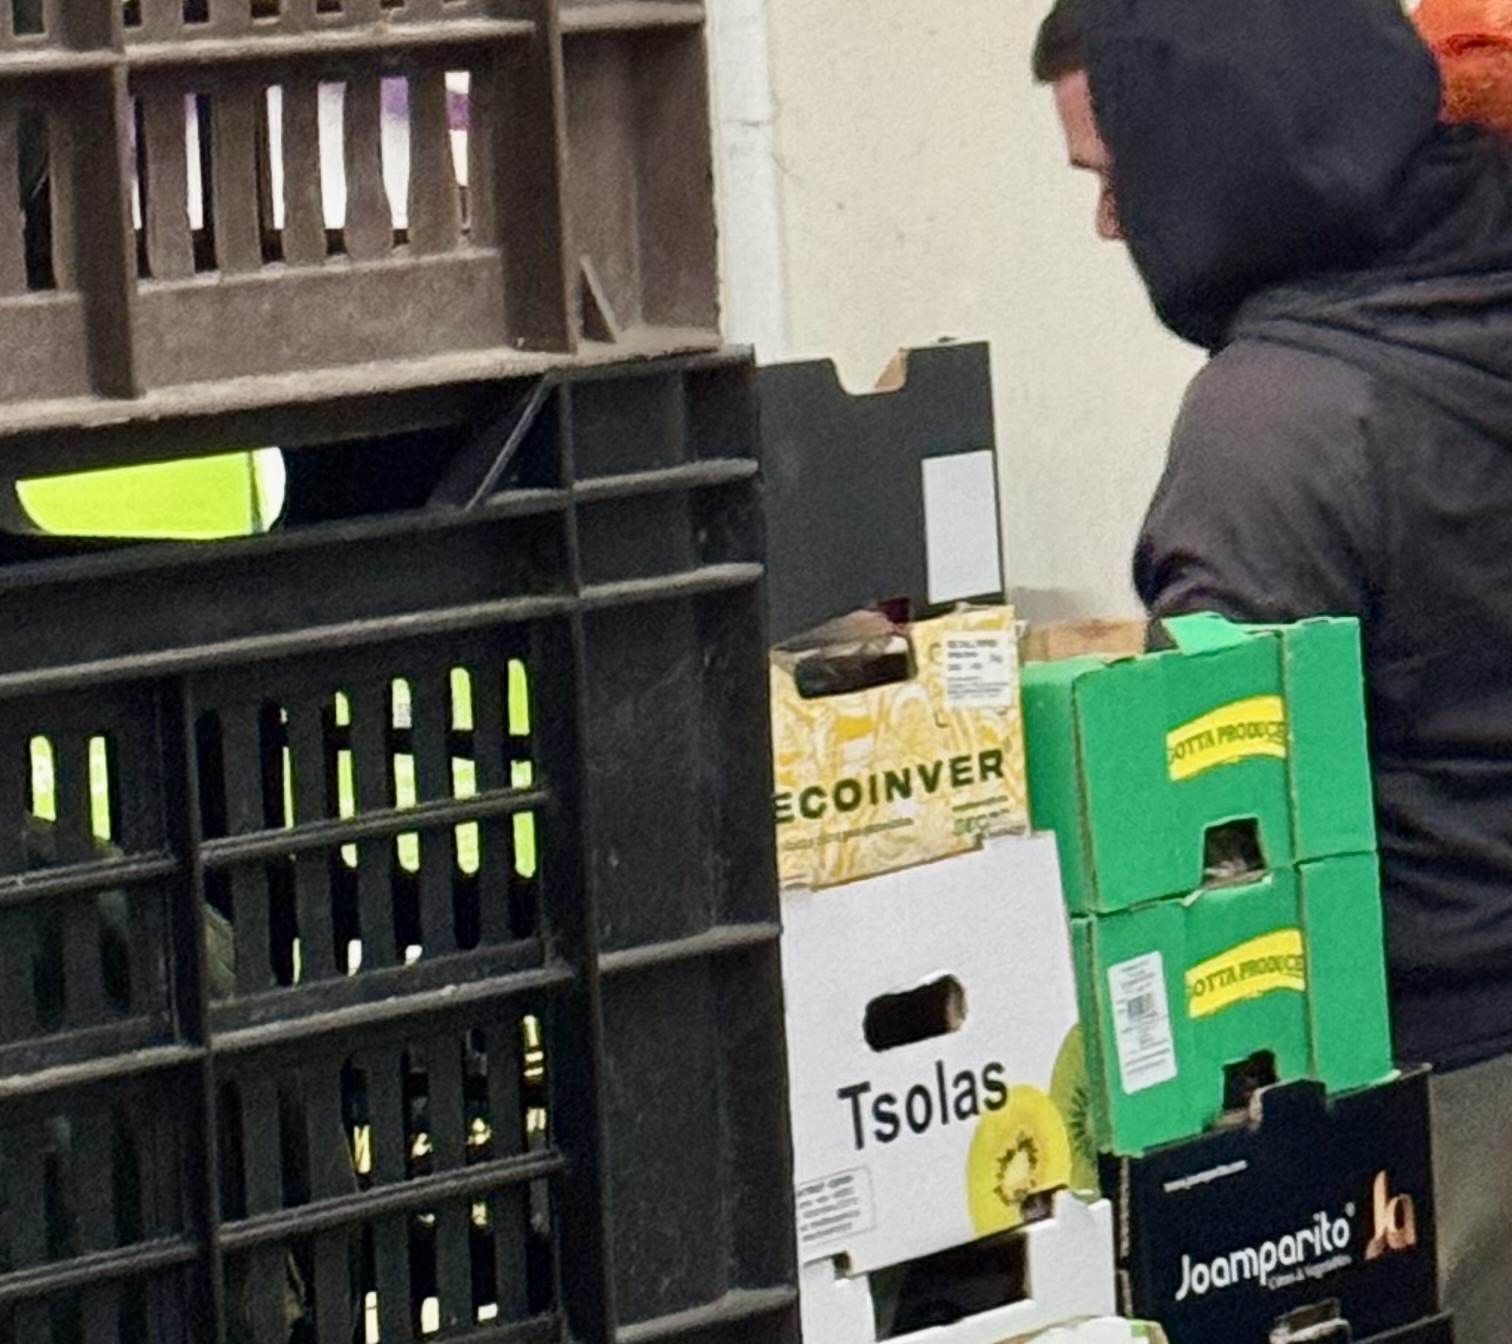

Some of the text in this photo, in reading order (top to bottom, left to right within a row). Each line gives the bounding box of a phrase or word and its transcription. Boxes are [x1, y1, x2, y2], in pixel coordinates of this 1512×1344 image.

[772, 748, 1005, 825] ECOINVER
[1187, 963, 1237, 998] OTTA
[837, 1061, 1009, 1150] Tsolas
[1174, 1210, 1351, 1302] Joamparito
